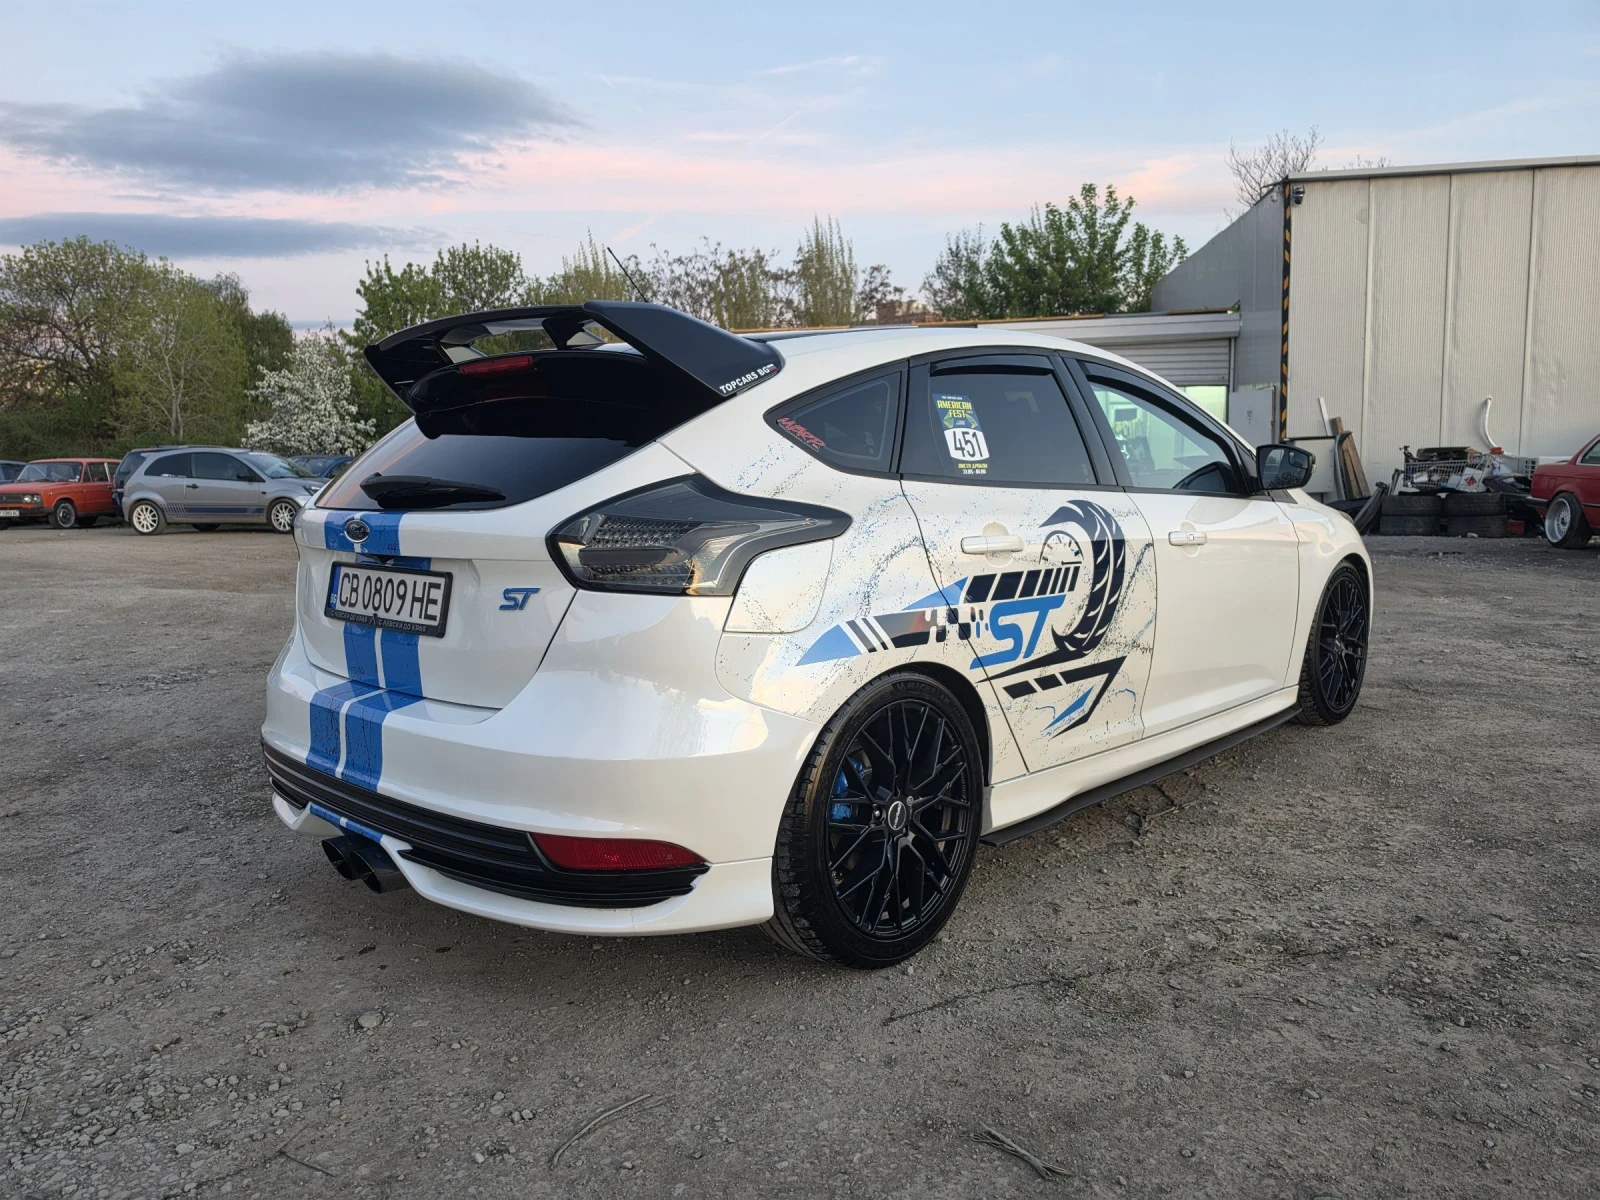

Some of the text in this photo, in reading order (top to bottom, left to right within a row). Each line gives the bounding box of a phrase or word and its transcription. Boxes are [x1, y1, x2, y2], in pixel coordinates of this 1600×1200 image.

[719, 366, 770, 394] TOPCARS BG
[937, 400, 972, 410] AMERICAN
[949, 409, 966, 418] FEST
[953, 430, 983, 458] 451
[499, 588, 541, 610] ST
[383, 620, 403, 629] ЛЕВСКИ
[969, 594, 1067, 670] ST
